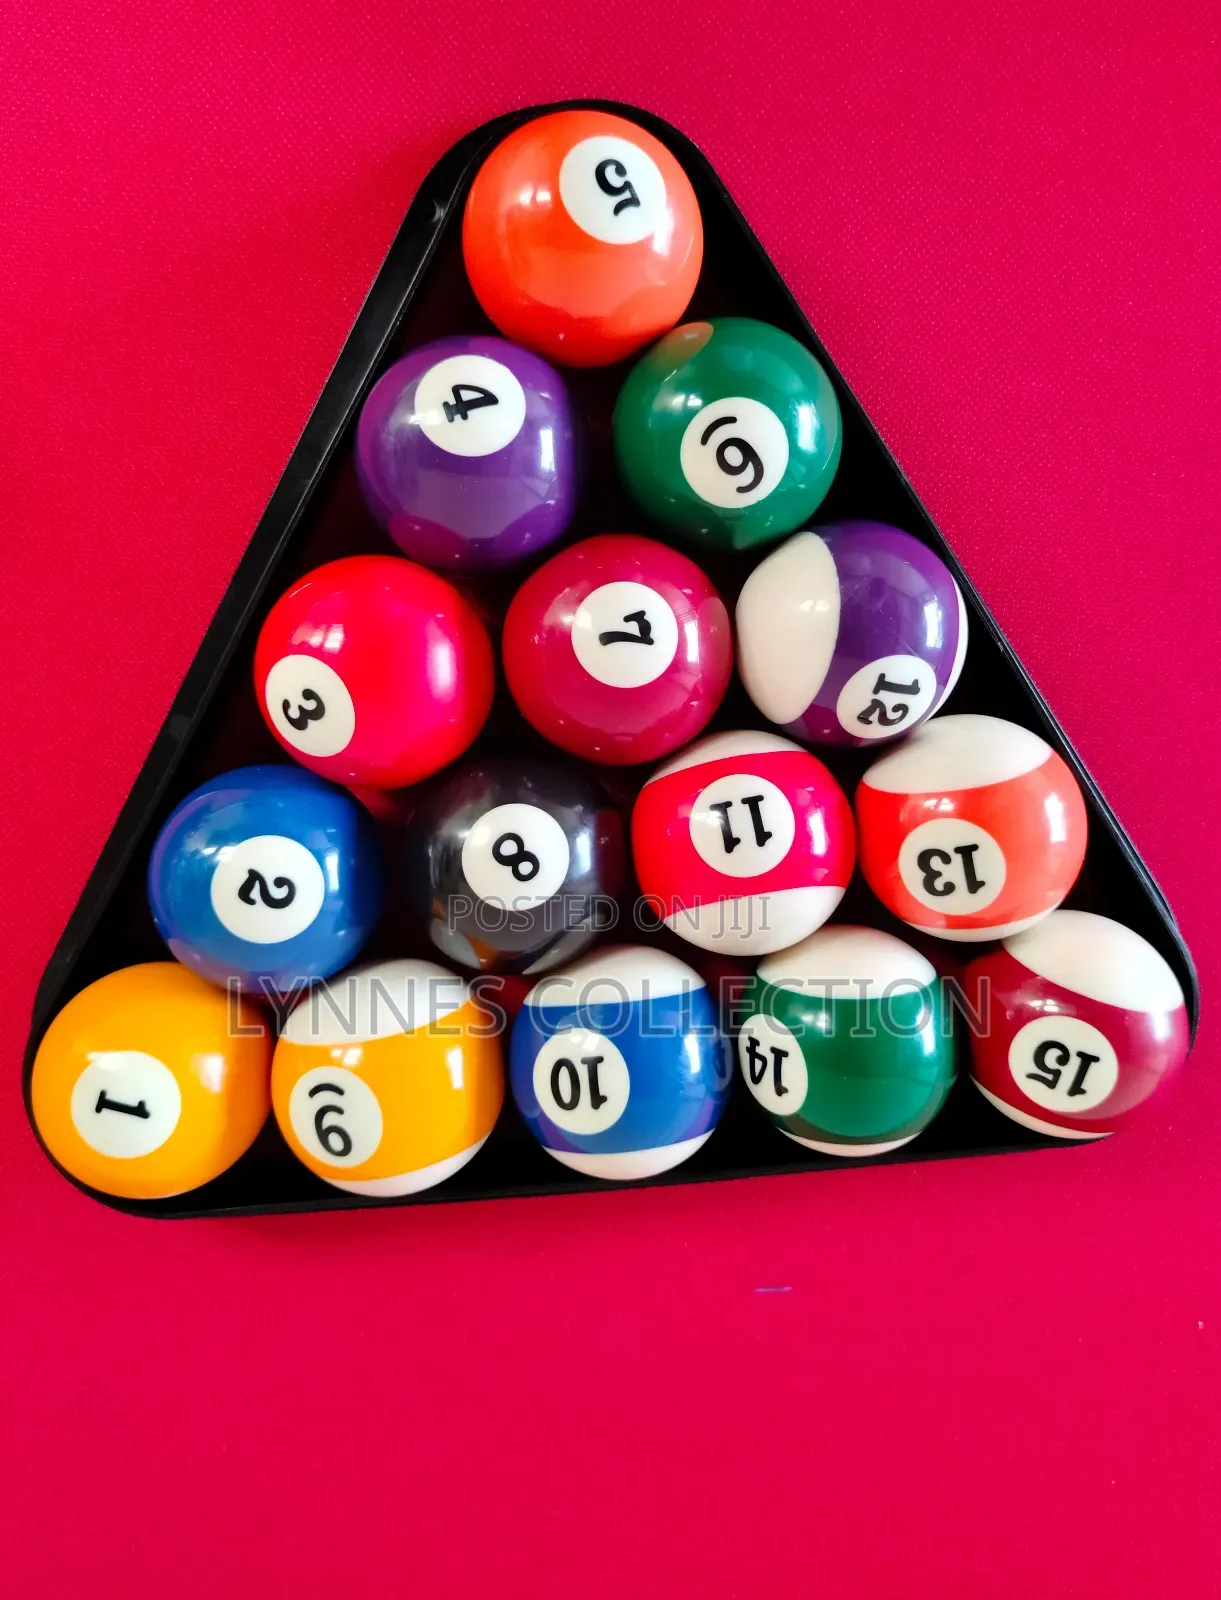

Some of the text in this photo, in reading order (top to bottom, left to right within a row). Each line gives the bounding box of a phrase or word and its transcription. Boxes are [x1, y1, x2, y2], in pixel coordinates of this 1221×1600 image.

[594, 159, 641, 216] 5
[442, 384, 499, 423] 4
[715, 436, 765, 494] 6
[598, 610, 655, 646] 7
[282, 688, 326, 731] 3
[856, 672, 921, 727] 12
[709, 794, 773, 854] 11
[491, 832, 540, 882] 8
[916, 843, 986, 897] 13
[237, 868, 296, 910] 2
[550, 1055, 608, 1111] 10
[745, 1034, 789, 1097] 14
[1025, 1040, 1101, 1097] 15
[94, 1090, 150, 1120] 1
[314, 1103, 353, 1156] 9
